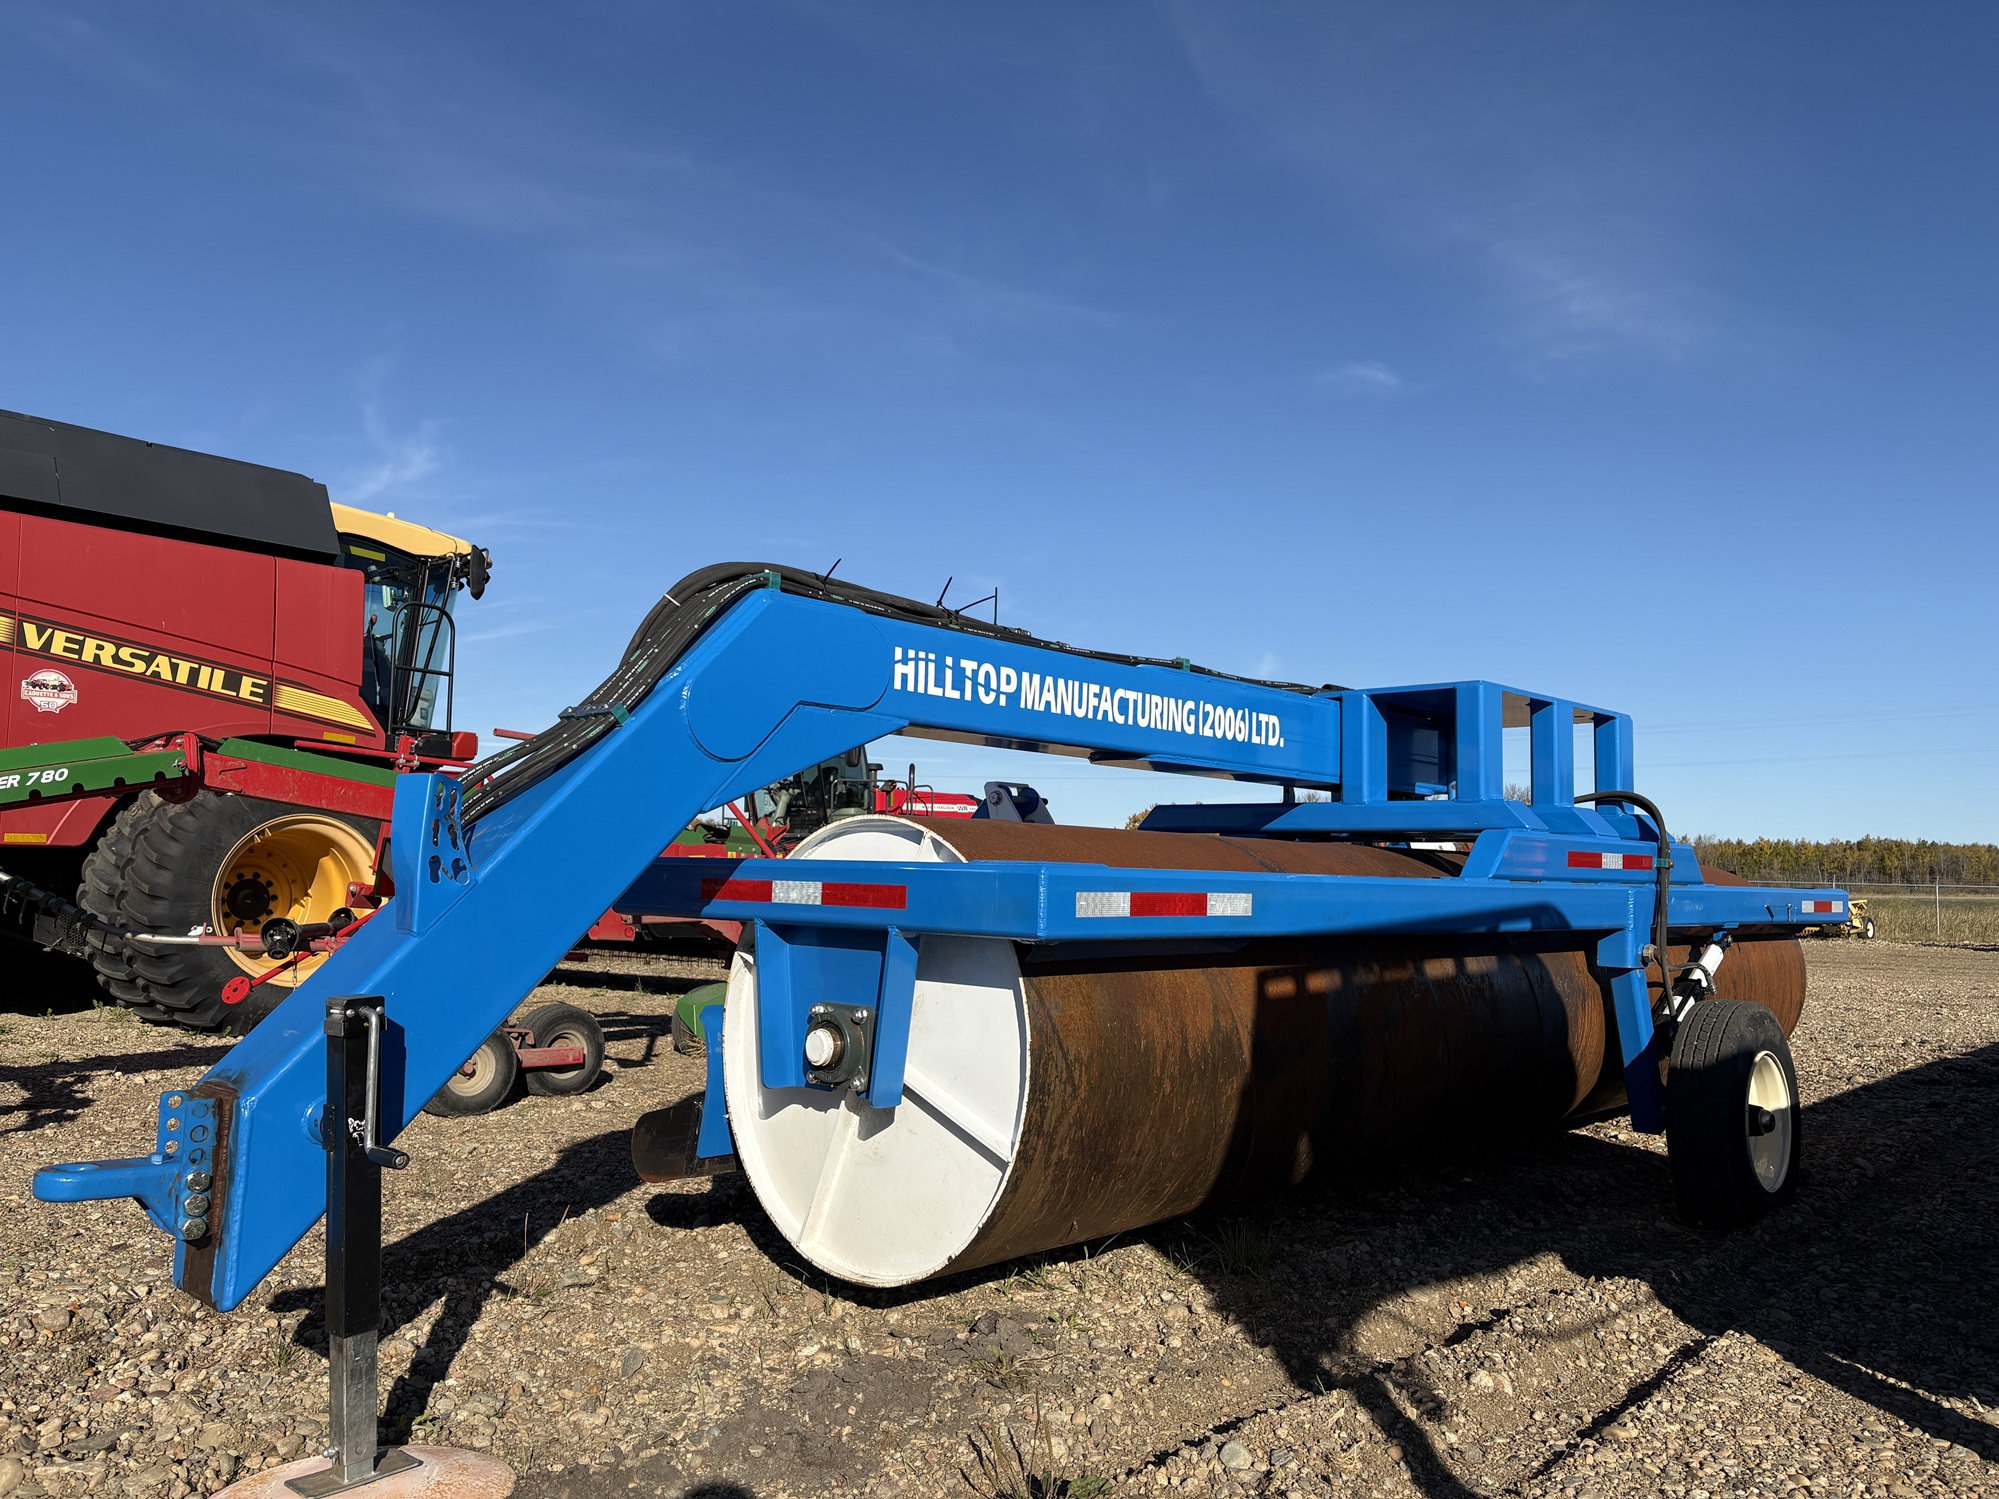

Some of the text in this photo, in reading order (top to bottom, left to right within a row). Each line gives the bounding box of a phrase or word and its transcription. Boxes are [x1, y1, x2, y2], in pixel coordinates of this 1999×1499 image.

[22, 621, 268, 703] VERSATILE
[893, 646, 1285, 748] HILLTOP MANUFACTURING (2006) LTD.
[25, 768, 69, 786] 780
